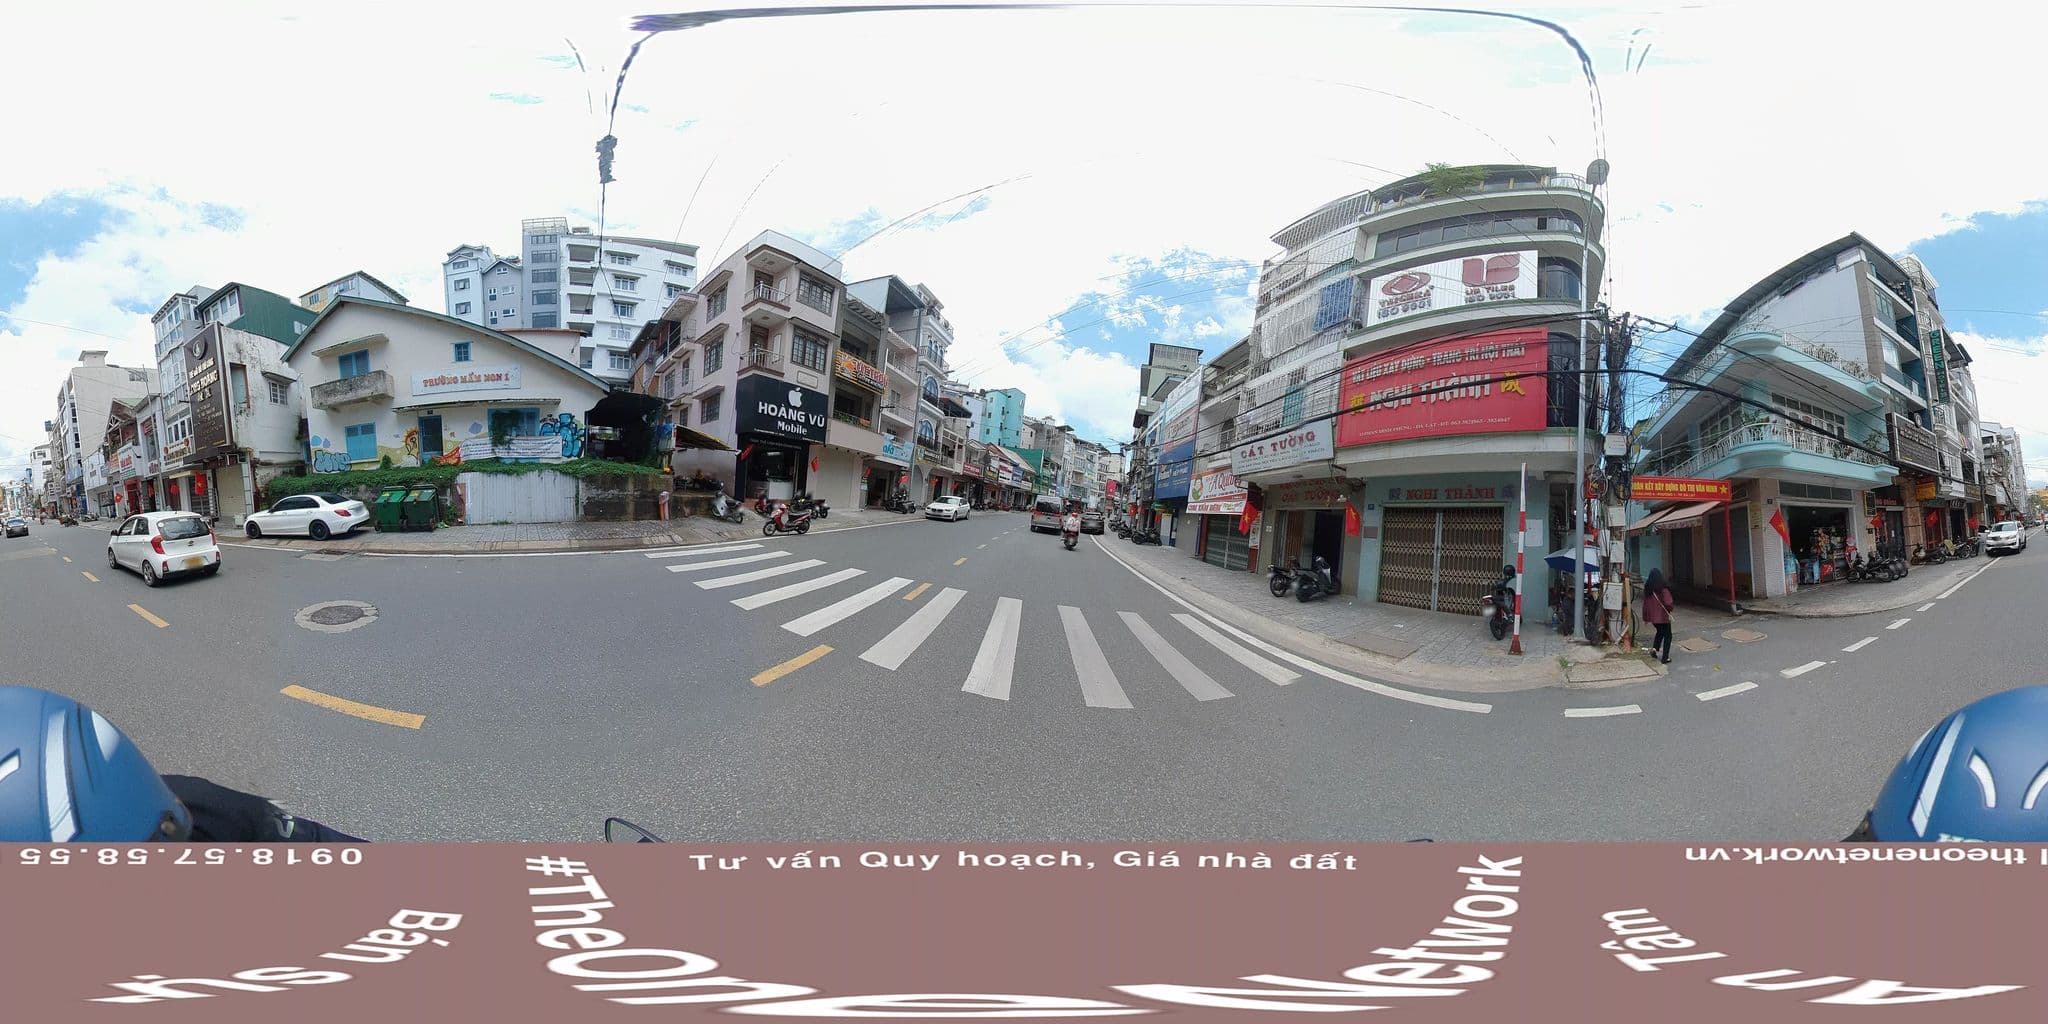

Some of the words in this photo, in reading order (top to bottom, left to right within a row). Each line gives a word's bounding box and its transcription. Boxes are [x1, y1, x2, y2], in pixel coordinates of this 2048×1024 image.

[1378, 307, 1400, 319] ISO
[1401, 298, 1432, 313] 9001
[1464, 294, 1485, 304] ISO
[1930, 331, 1945, 369] GREEN
[484, 373, 502, 382] NON
[1369, 383, 1414, 412] NGHI
[1418, 372, 1491, 405] THÀNH
[758, 401, 806, 423] HOÀNG
[808, 413, 825, 428] VŨ
[777, 420, 808, 436] Mobile
[1240, 444, 1265, 459] CÁT
[1271, 431, 1316, 452] TƯỜNG
[1406, 488, 1437, 499] NGHI
